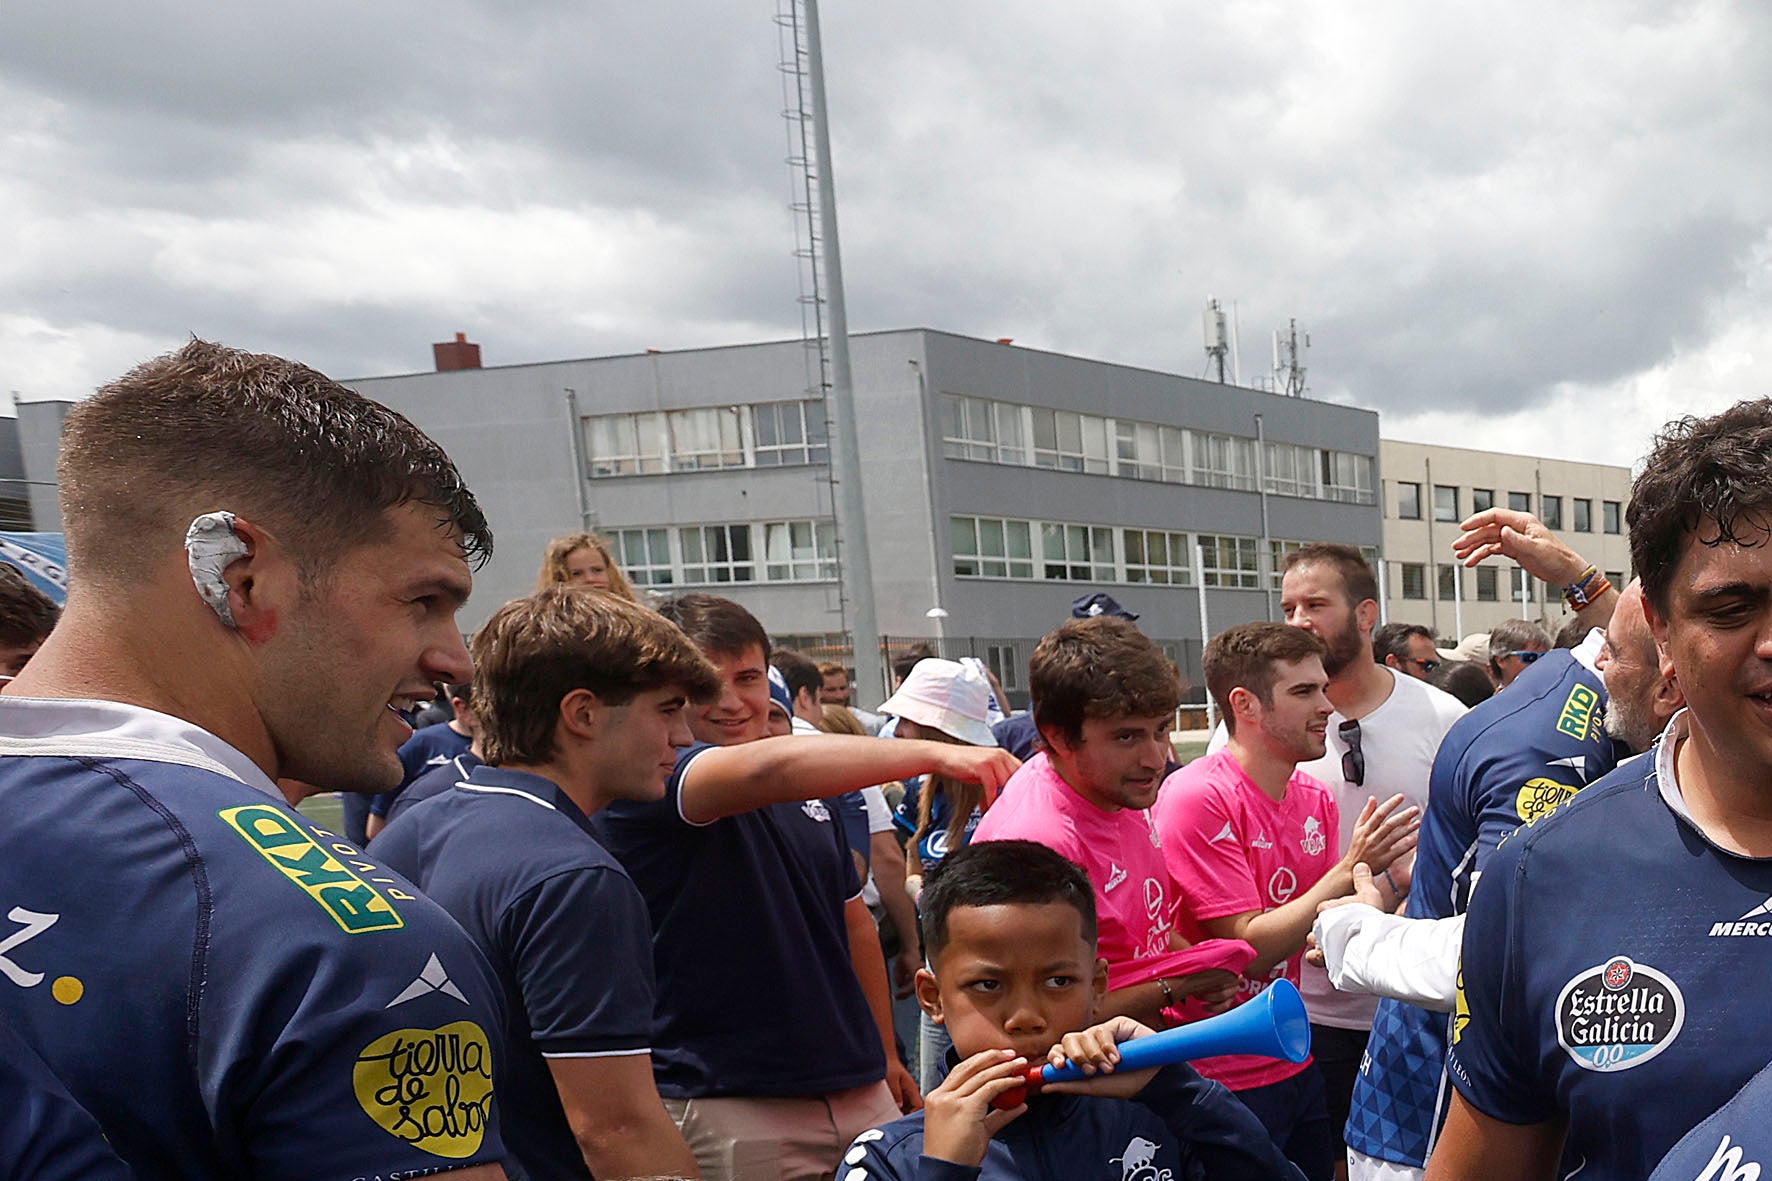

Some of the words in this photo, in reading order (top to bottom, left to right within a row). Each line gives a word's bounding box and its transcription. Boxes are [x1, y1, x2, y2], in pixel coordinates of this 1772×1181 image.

[1560, 687, 1594, 738] RKD
[233, 807, 400, 930] RKD
[309, 825, 417, 902] PIVOT
[1569, 987, 1665, 1017] Estrella
[1570, 1014, 1656, 1045] Galicia
[358, 1033, 492, 1079] tierra
[375, 1076, 431, 1106] de
